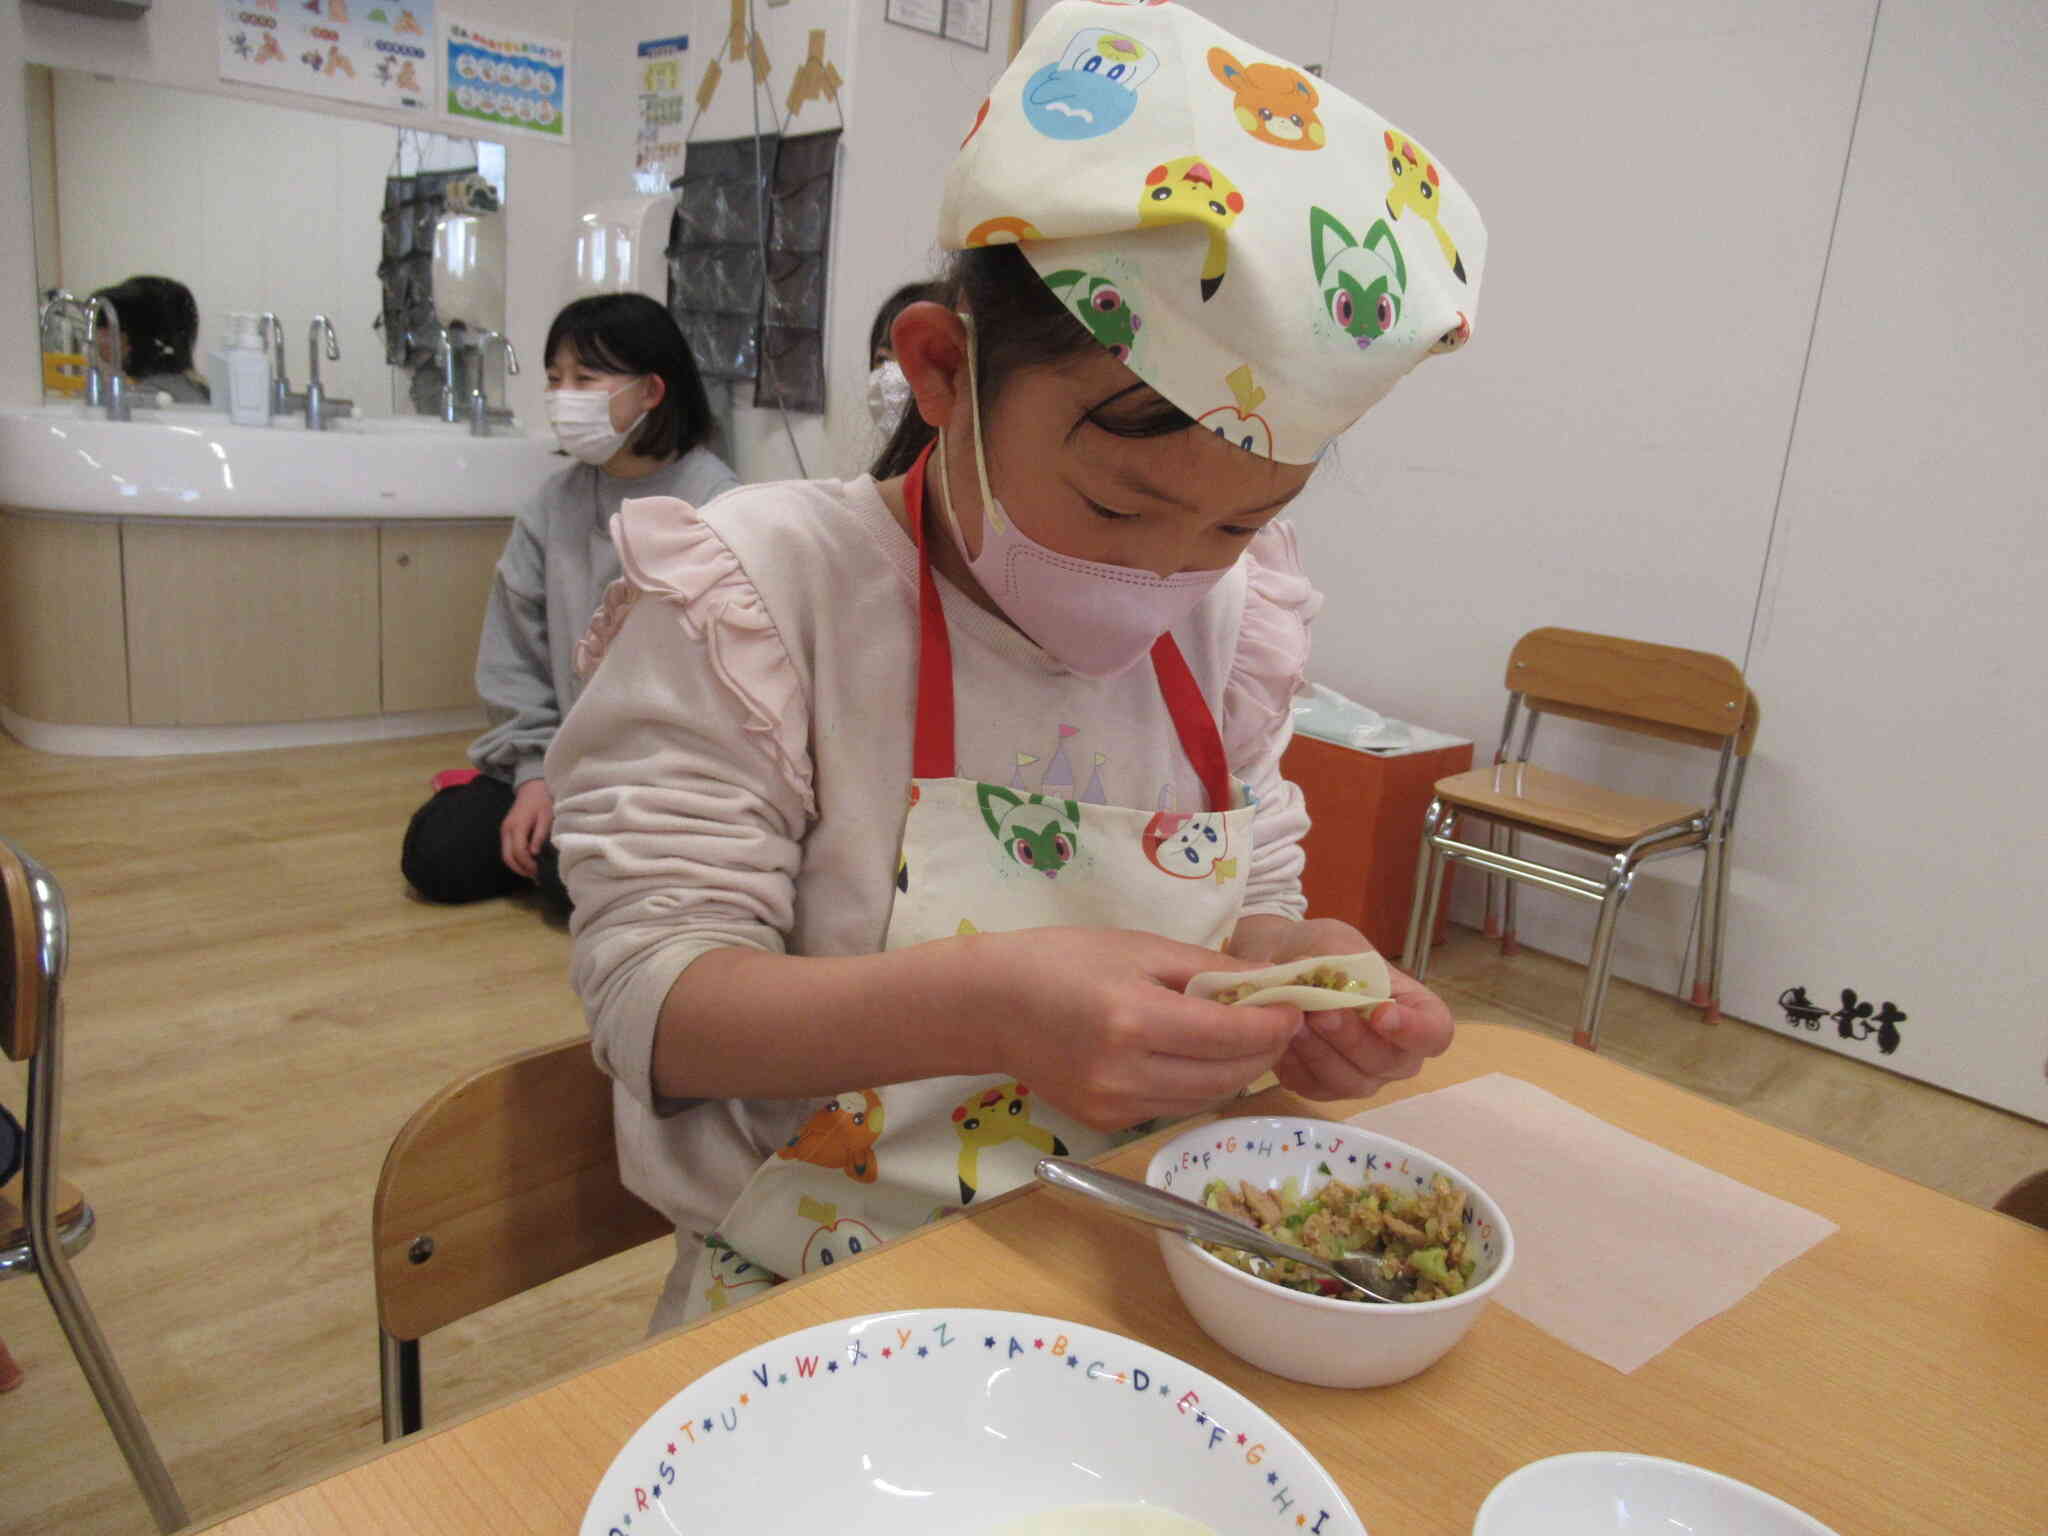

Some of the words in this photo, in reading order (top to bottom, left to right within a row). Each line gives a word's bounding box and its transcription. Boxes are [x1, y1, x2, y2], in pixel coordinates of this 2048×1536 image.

[1182, 1151, 1189, 1169] E
[1202, 1151, 1211, 1170] F
[1226, 1136, 1238, 1153] G
[1258, 1141, 1272, 1157] H
[1293, 1130, 1306, 1146] I
[1328, 1138, 1344, 1153] J
[1365, 1153, 1377, 1170] K
[1400, 1159, 1409, 1175] L
[1462, 1207, 1473, 1224] N
[634, 1487, 650, 1512] R
[659, 1461, 675, 1485] S
[680, 1420, 695, 1443] T
[721, 1406, 737, 1431] U
[752, 1363, 768, 1388] V
[795, 1355, 818, 1378] W
[846, 1339, 868, 1366] X
[896, 1328, 911, 1350] Y
[932, 1322, 955, 1348] Z
[1008, 1336, 1024, 1359] A
[1051, 1335, 1068, 1356] B
[1087, 1361, 1105, 1379] C
[1133, 1368, 1150, 1391] D
[1177, 1391, 1199, 1414] E
[1209, 1426, 1226, 1449] F
[1247, 1443, 1264, 1464] G
[1272, 1487, 1294, 1514] H
[1312, 1510, 1329, 1534] I
